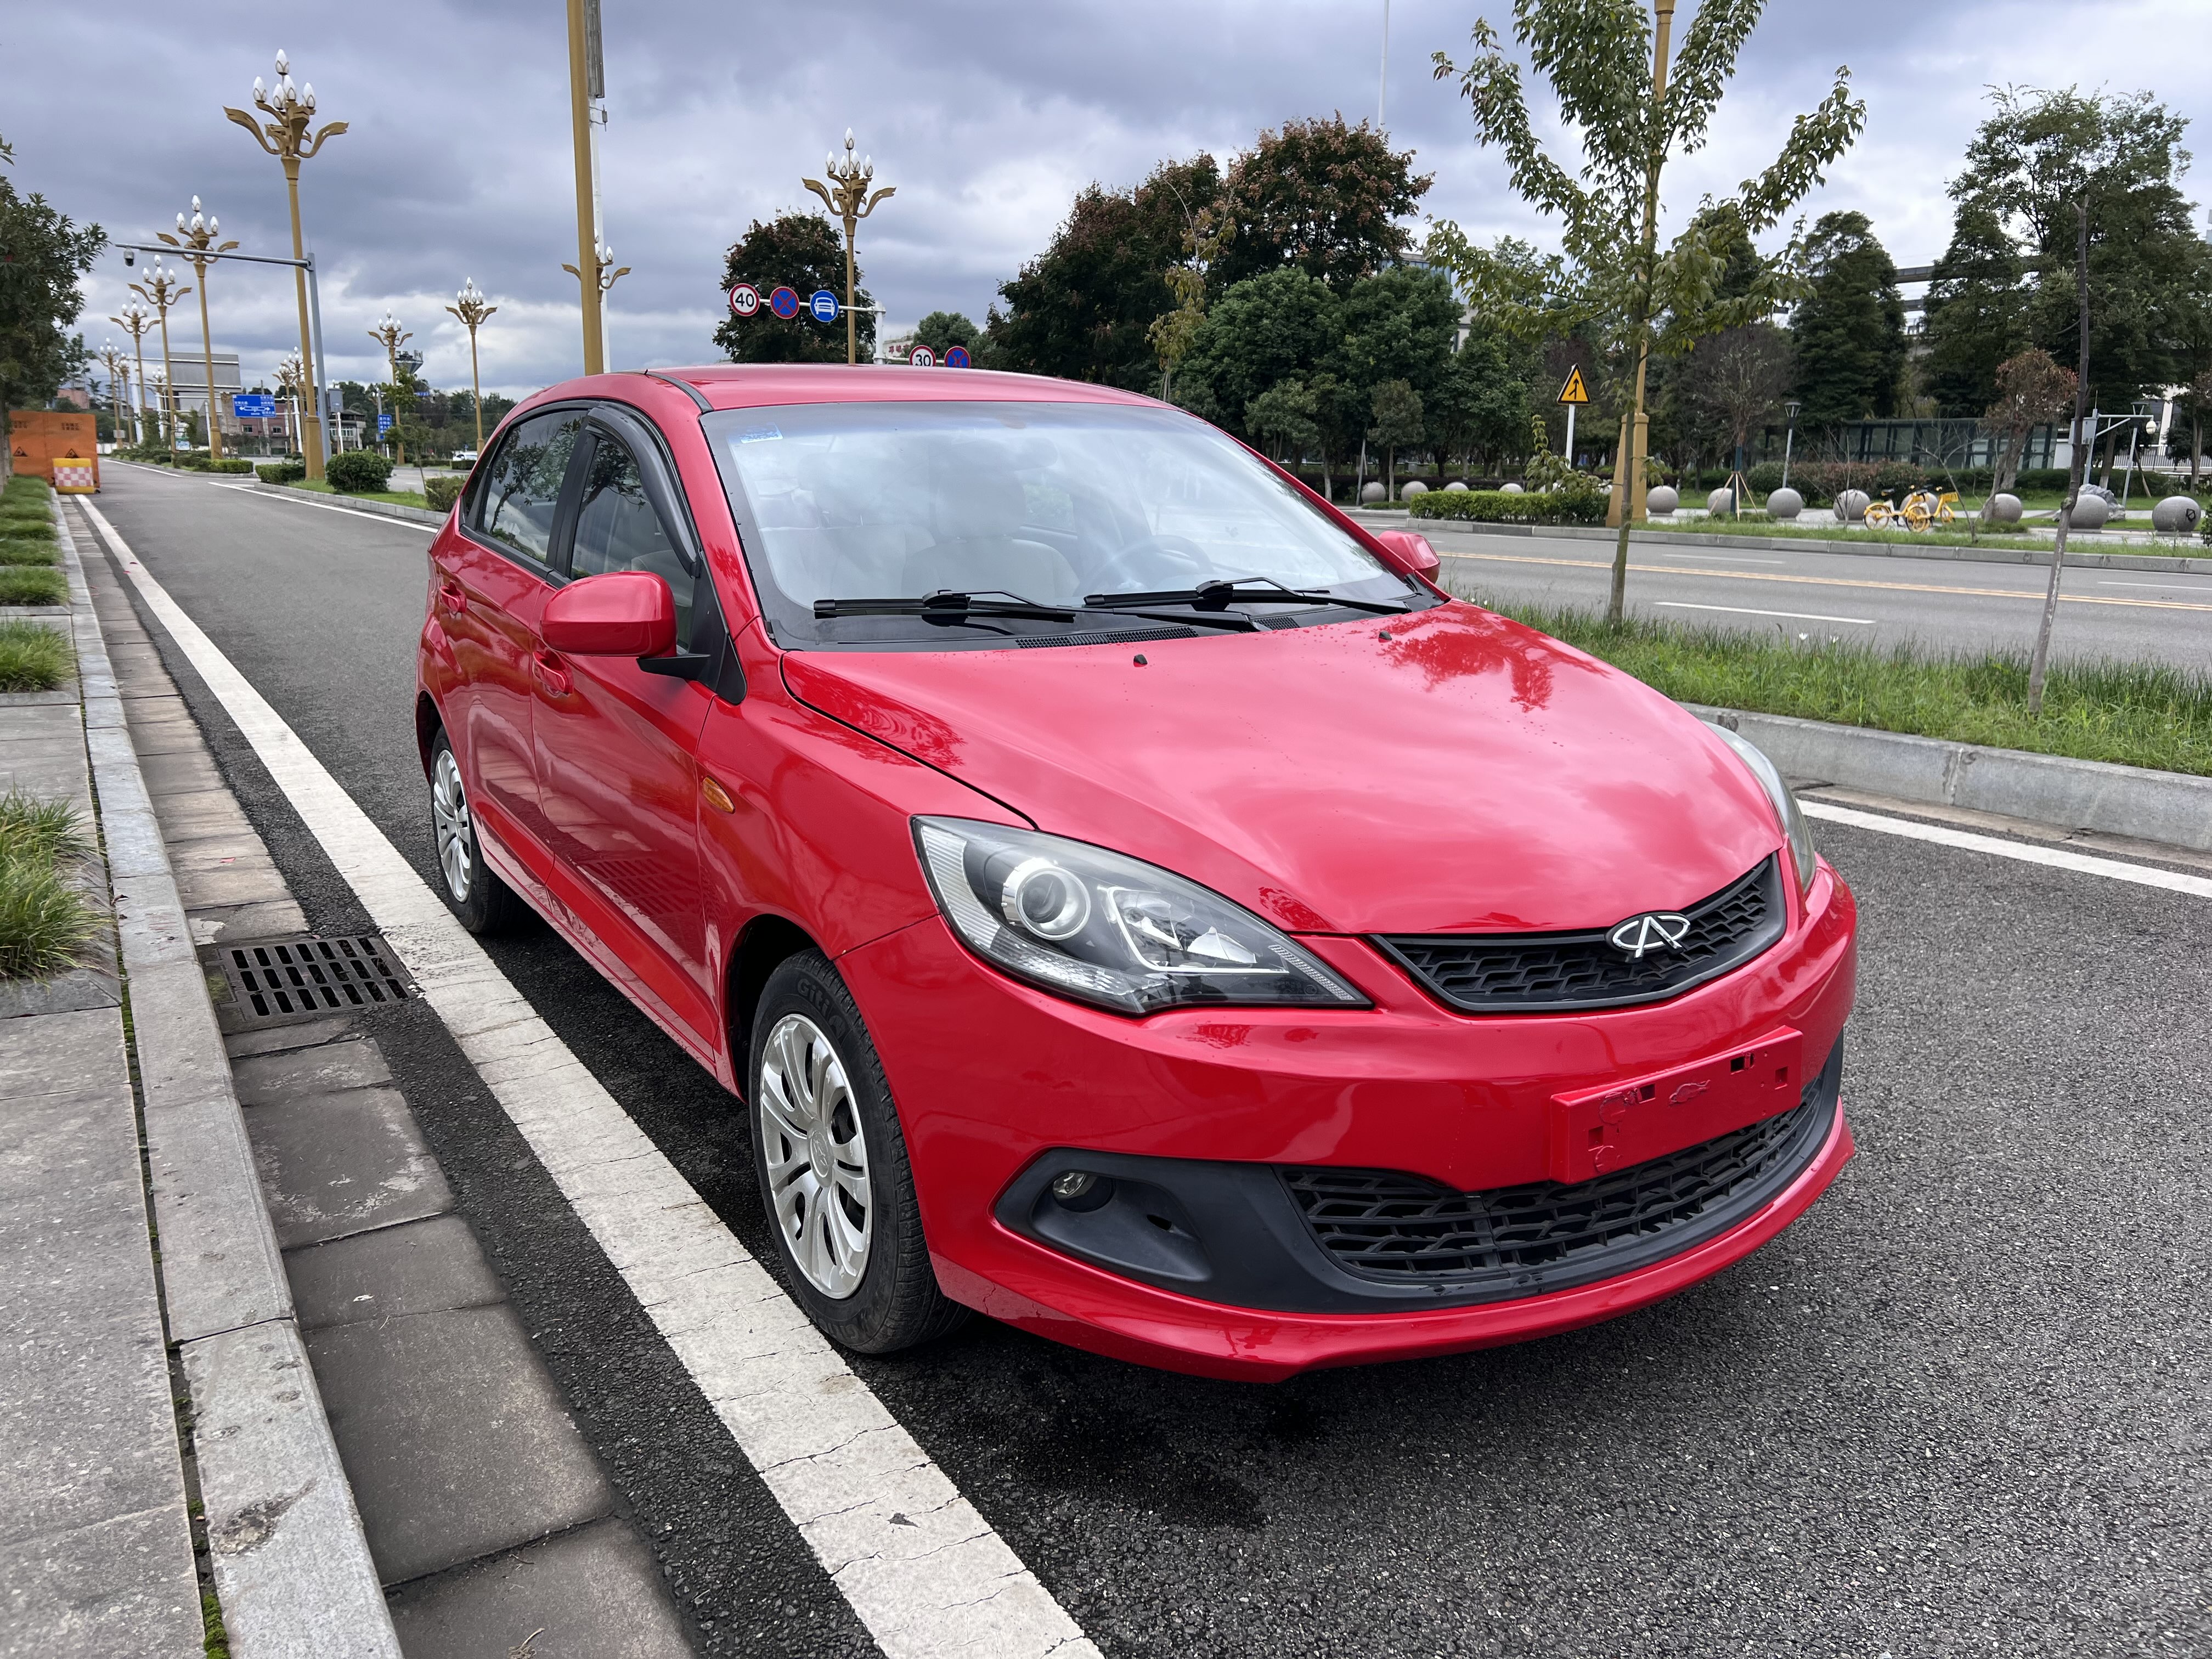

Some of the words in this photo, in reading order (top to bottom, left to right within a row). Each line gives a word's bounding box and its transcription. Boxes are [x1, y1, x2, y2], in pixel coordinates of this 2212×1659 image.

[735, 292, 754, 307] 40
[915, 354, 931, 366] 30
[798, 979, 830, 1017] Giti
